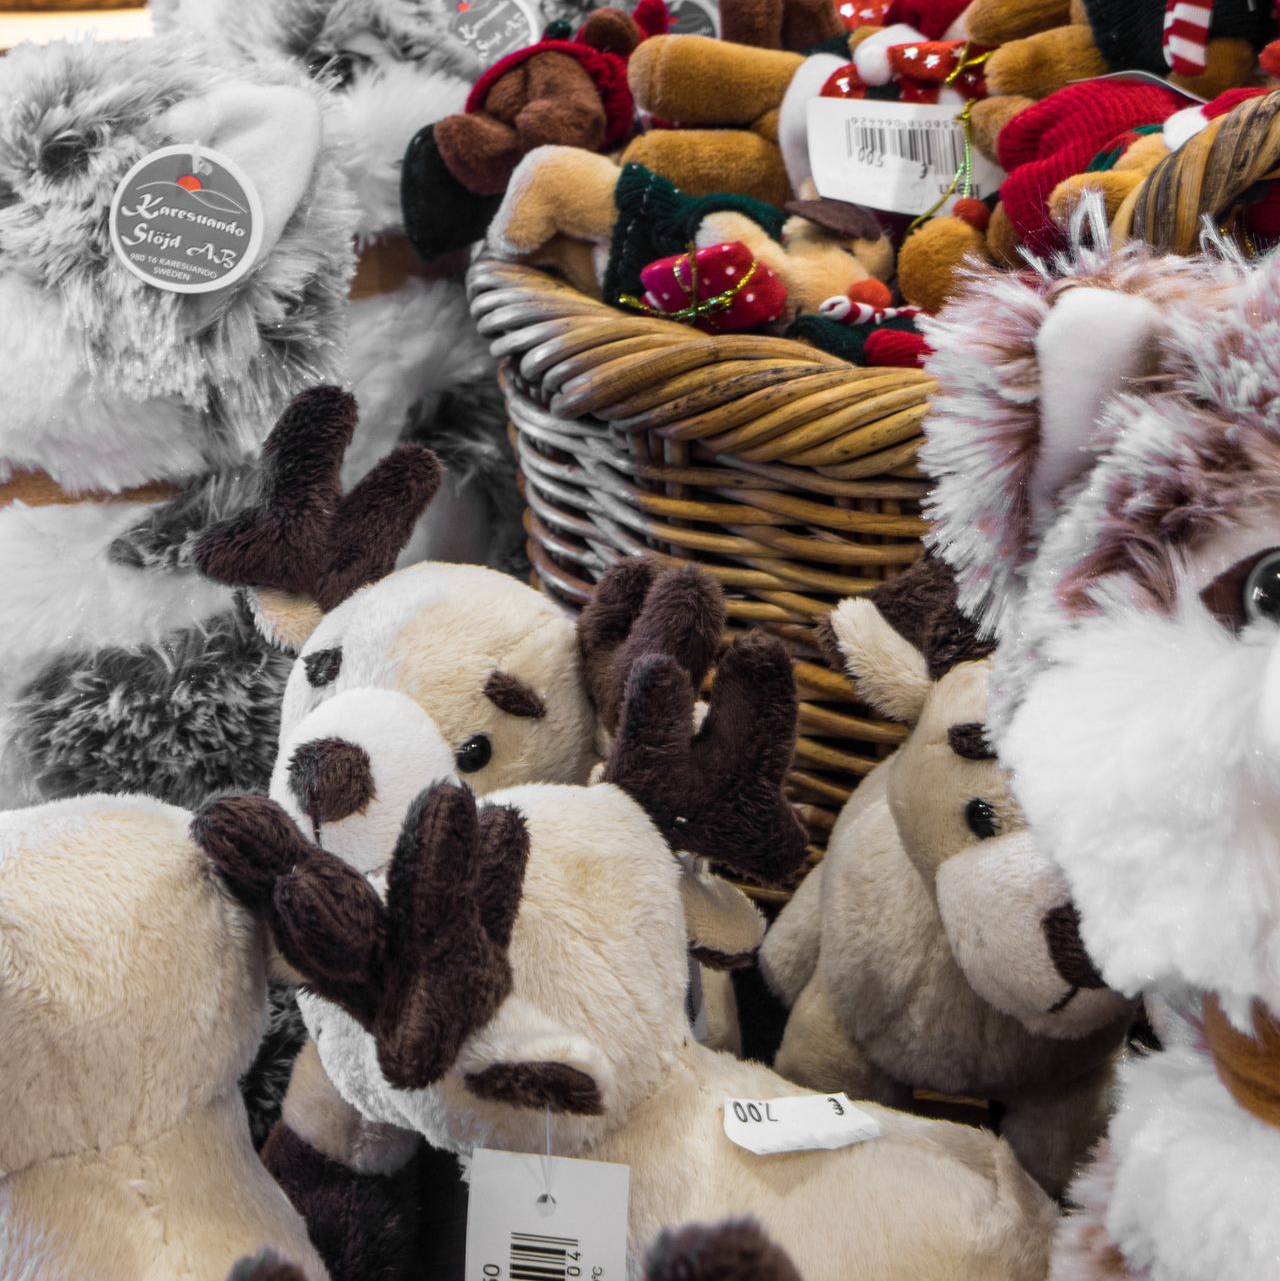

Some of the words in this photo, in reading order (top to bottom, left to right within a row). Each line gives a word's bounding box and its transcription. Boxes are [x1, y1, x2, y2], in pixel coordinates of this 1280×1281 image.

[121, 194, 245, 237] Karesuando
[121, 223, 182, 250] Slöjd
[186, 243, 237, 268] AB
[130, 253, 145, 262] 980
[148, 256, 157, 264] 16
[158, 257, 218, 279] KARESUANDO
[153, 266, 191, 281] SWEDEN
[733, 1100, 779, 1123] 7.00
